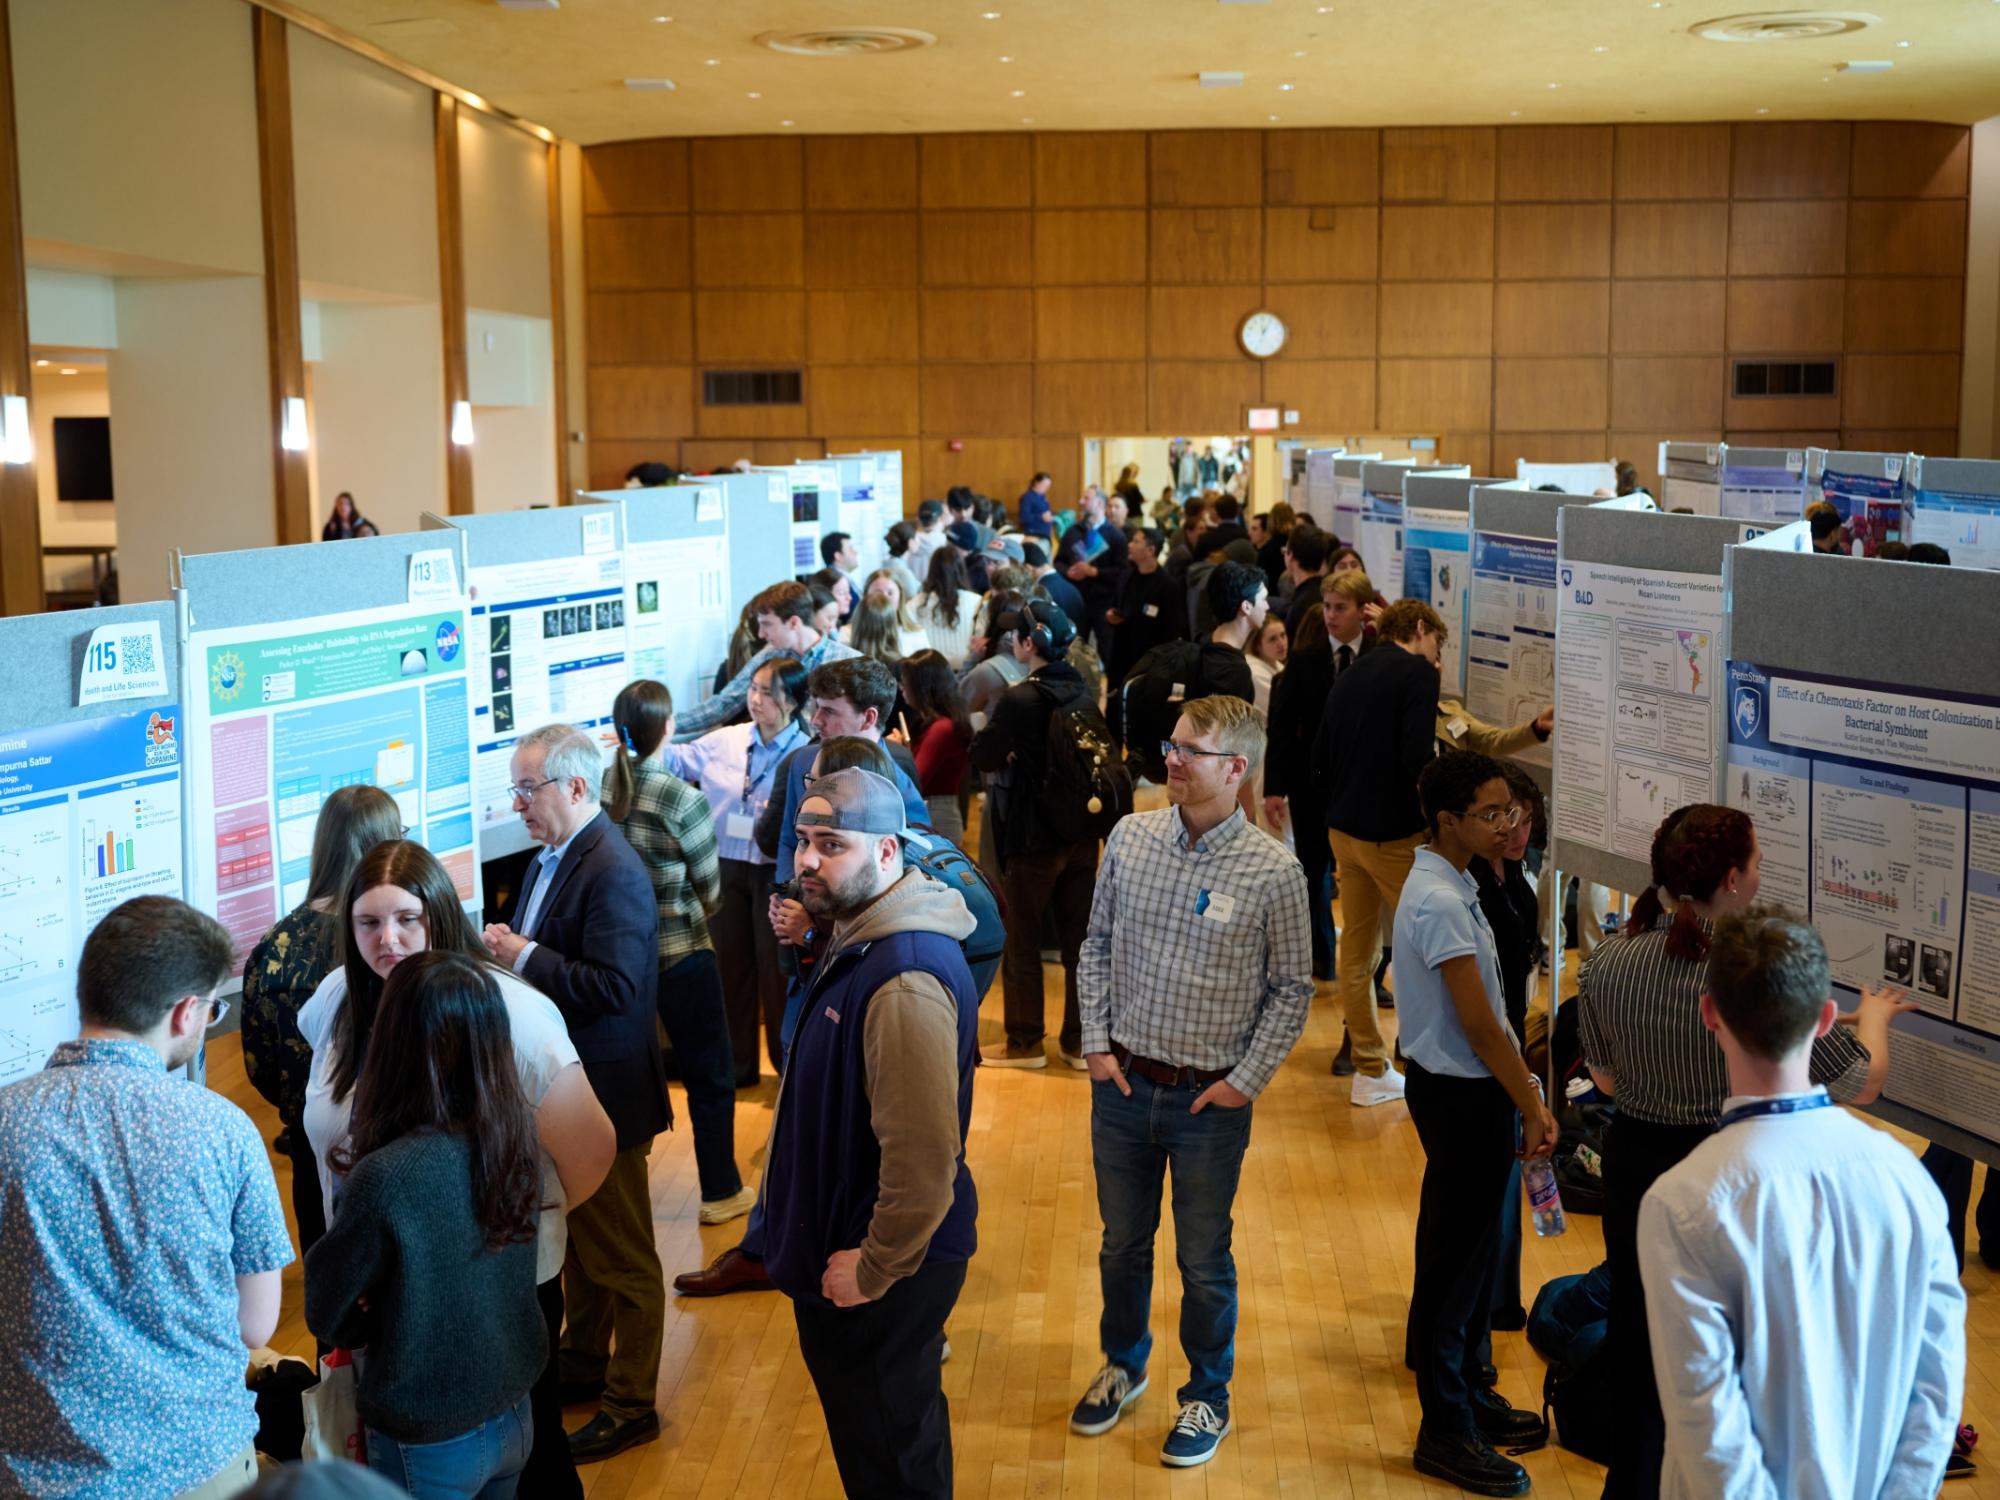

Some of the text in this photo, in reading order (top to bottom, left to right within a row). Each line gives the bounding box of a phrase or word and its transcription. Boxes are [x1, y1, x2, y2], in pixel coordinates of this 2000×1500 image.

[414, 561, 431, 581] 113
[1642, 577, 1666, 588] Spanish
[1666, 579, 1688, 590] Accent
[1688, 582, 1716, 593] Varieties
[1654, 590, 1681, 602] Listeners
[89, 641, 117, 673] 115
[114, 682, 126, 691] Life
[127, 680, 160, 690] Sciences
[1776, 686, 1798, 700] Effect
[1800, 690, 1810, 701] of
[1815, 691, 1864, 710] Chemotaxis
[1865, 699, 1892, 715] Factor
[1894, 707, 1907, 716] on
[1908, 705, 1931, 720] Host
[1932, 708, 1993, 730] Colonization
[1845, 714, 1928, 740] Bacterial Symbiont
